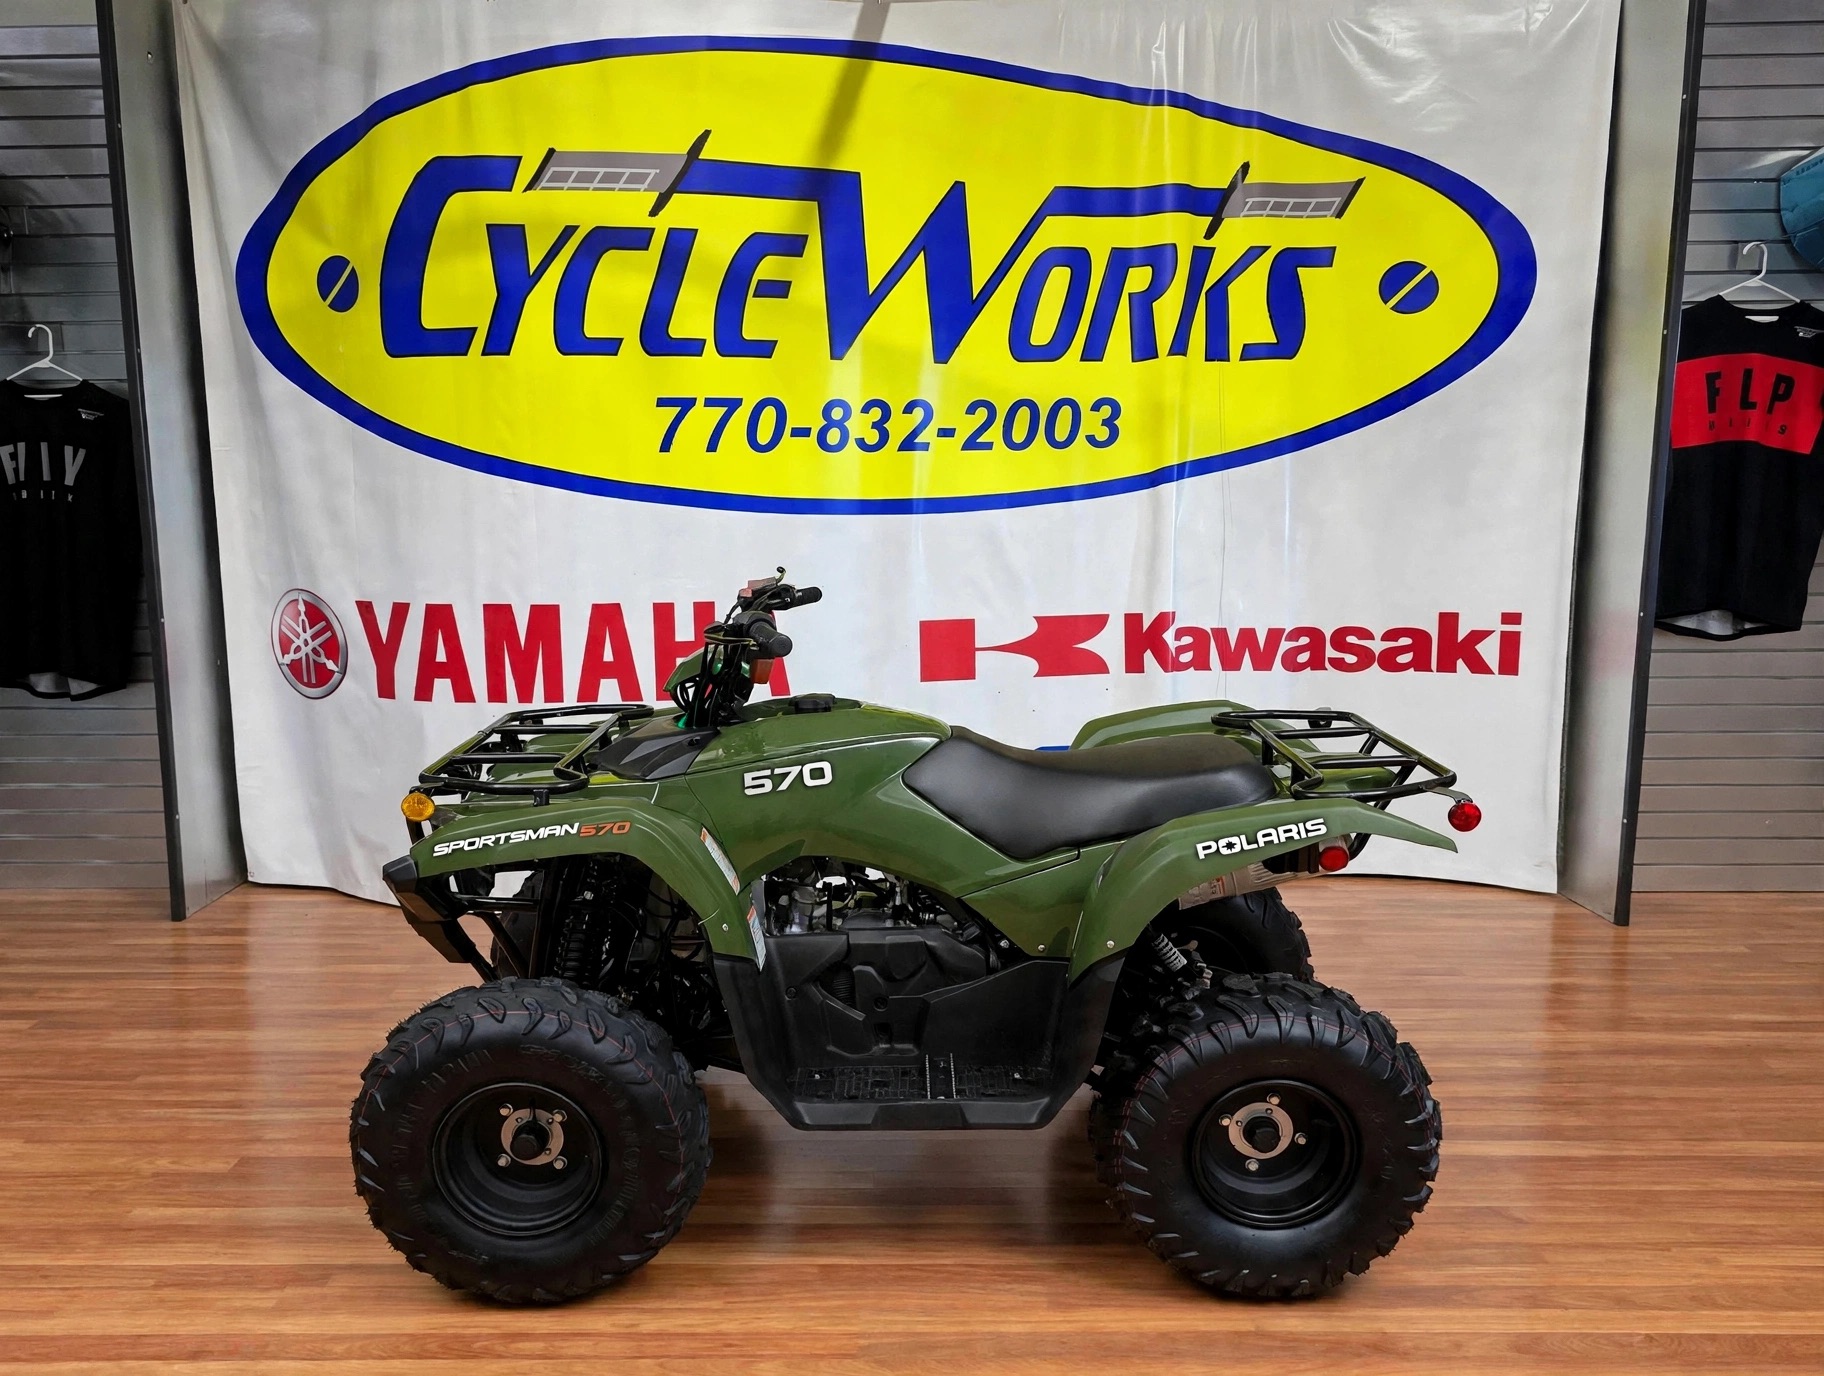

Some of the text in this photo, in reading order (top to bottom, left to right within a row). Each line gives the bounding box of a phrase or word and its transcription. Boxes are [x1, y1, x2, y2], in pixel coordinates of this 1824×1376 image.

[1705, 367, 1796, 415] FLP
[655, 396, 1122, 454] 770-832-2003
[1124, 611, 1523, 677] Kawasaki
[743, 760, 833, 796] 570
[1195, 817, 1328, 860] POLARIS
